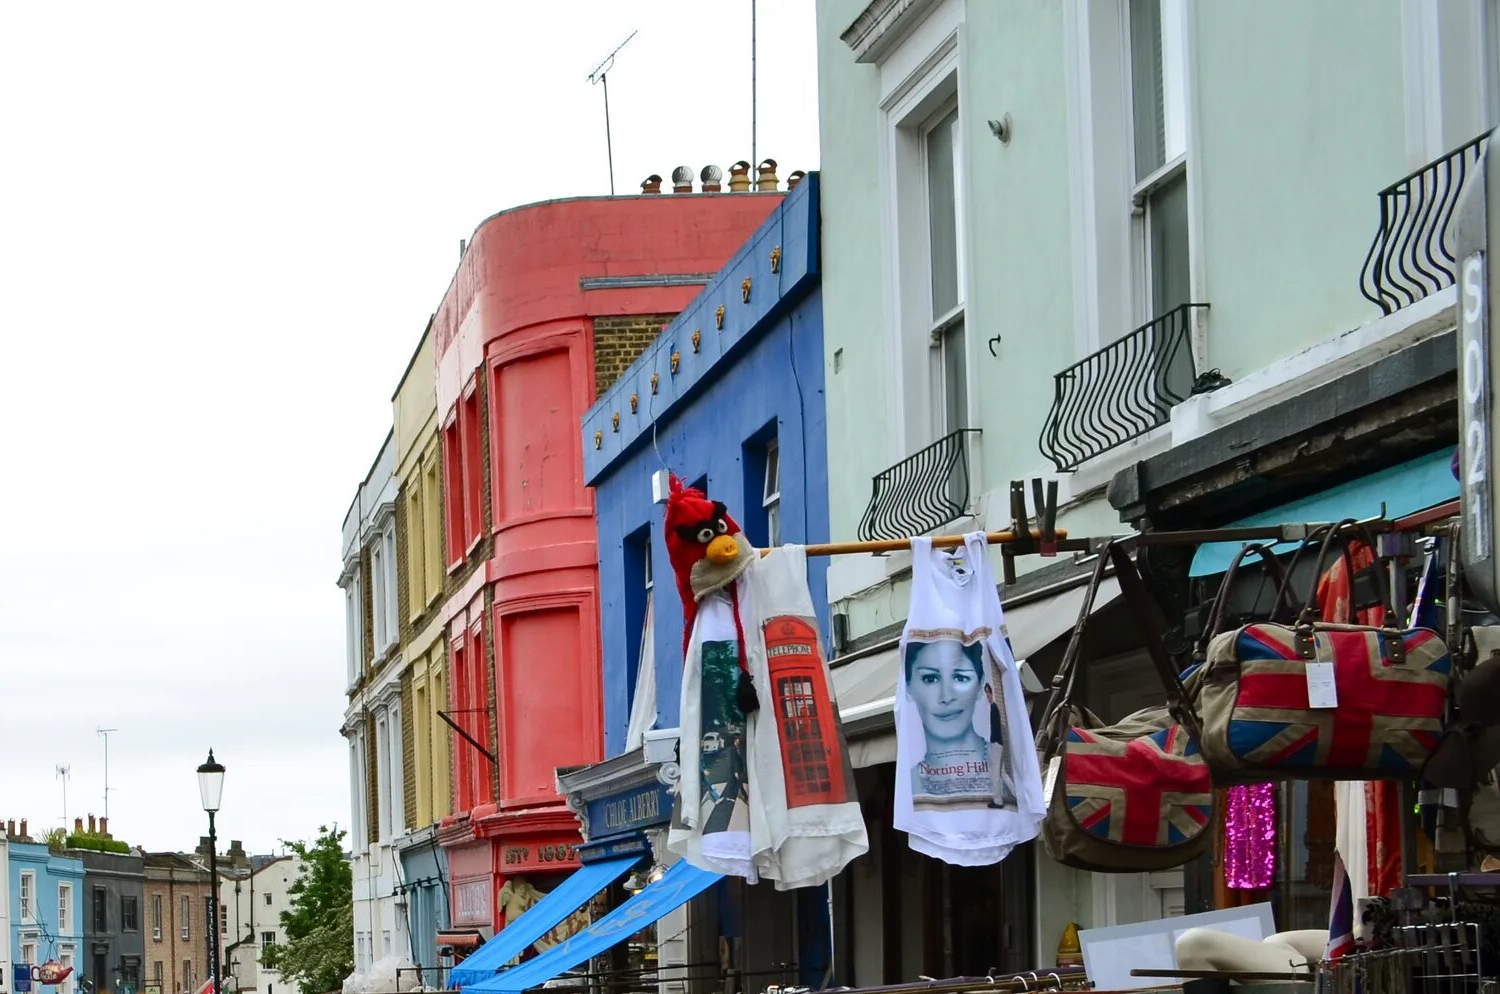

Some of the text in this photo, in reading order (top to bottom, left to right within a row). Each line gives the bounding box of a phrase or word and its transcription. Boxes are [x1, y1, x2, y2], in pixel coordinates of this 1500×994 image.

[767, 644, 810, 656] TELEPHONE
[920, 760, 988, 777] Notting Hill
[605, 789, 660, 828] CHLOE ALBERRY
